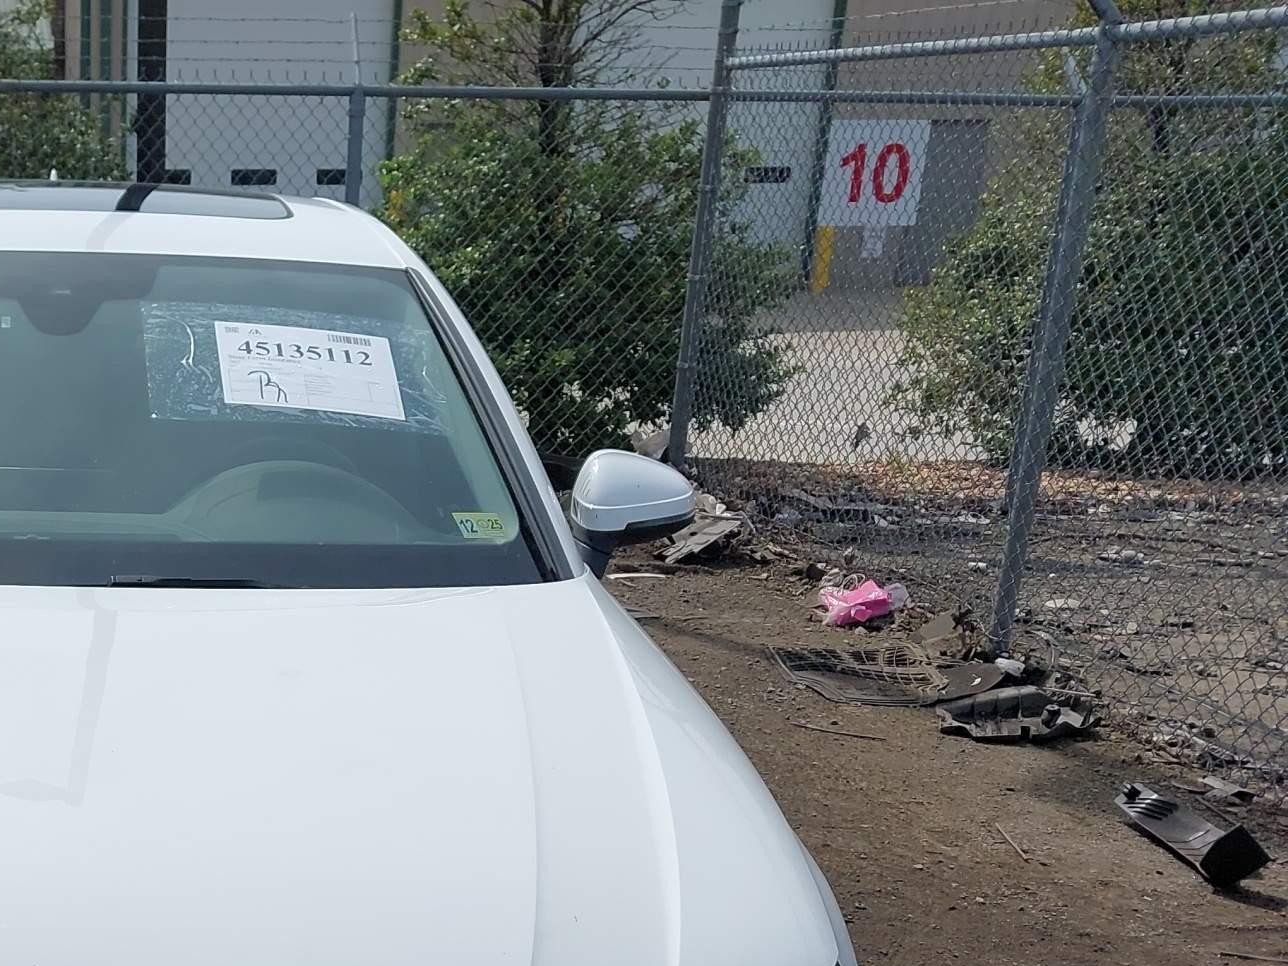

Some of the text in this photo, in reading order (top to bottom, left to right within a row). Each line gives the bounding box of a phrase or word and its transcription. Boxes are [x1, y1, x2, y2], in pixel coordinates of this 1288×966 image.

[839, 143, 910, 203] 10
[238, 340, 373, 366] 45135112
[459, 519, 503, 533] 12 25
